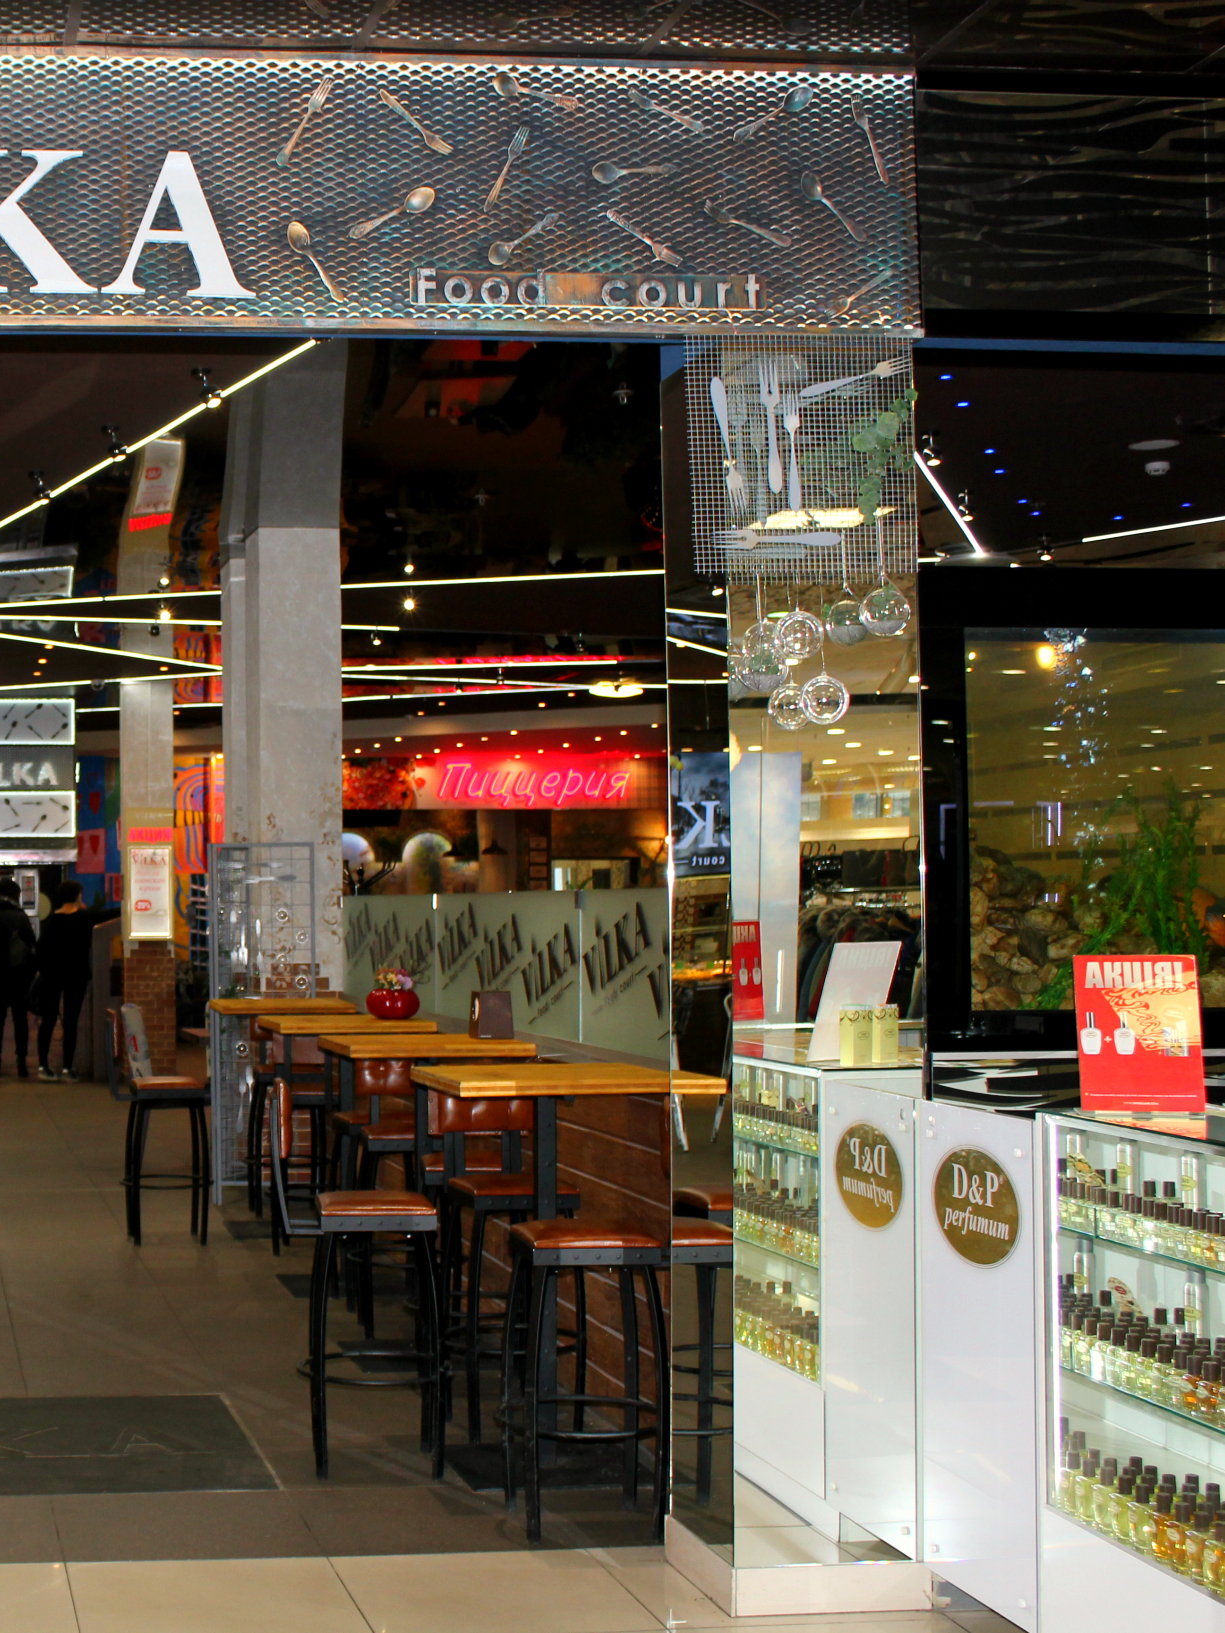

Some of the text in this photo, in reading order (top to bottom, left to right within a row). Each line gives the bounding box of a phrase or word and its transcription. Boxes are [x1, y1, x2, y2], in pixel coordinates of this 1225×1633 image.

[415, 267, 760, 310] Food court
[438, 762, 632, 807] Пиццерия
[127, 826, 174, 845] АКЦИЯ
[520, 922, 579, 1008] VILKA
[582, 901, 652, 996] VILKA
[951, 1162, 1001, 1208] D&P
[943, 1206, 1010, 1241] perfumum
